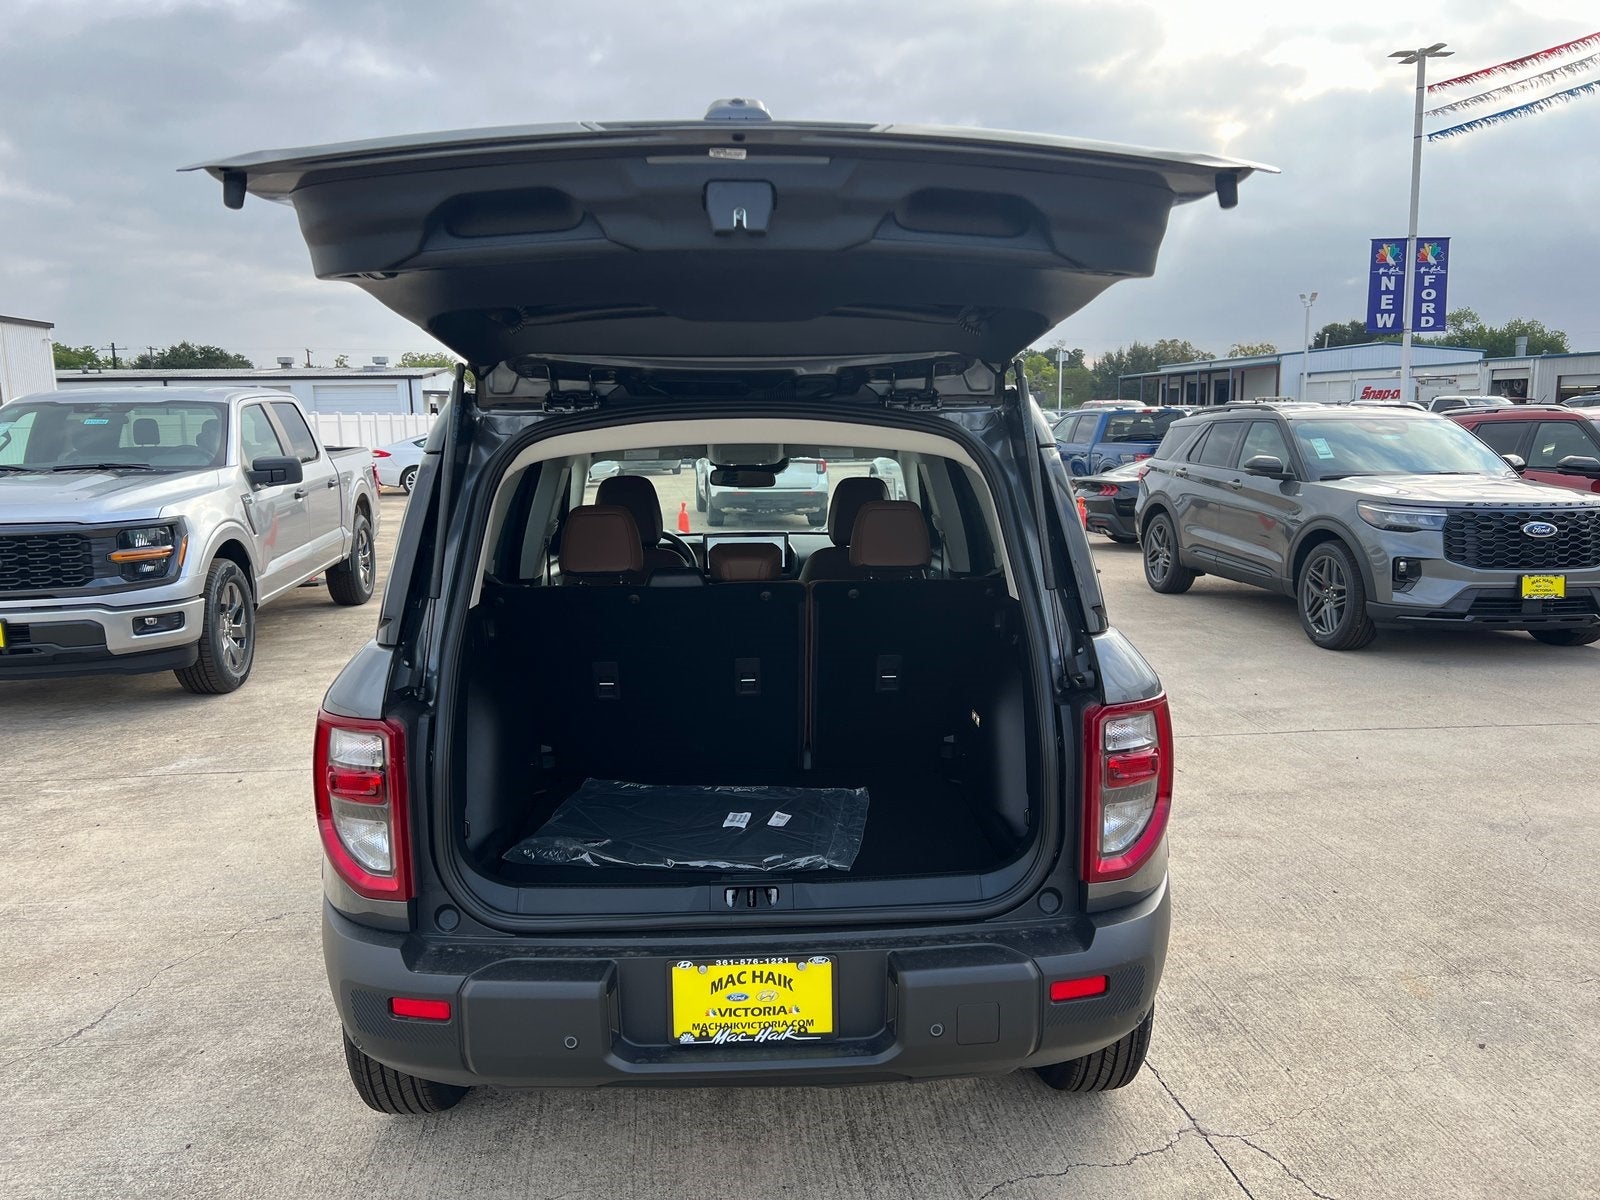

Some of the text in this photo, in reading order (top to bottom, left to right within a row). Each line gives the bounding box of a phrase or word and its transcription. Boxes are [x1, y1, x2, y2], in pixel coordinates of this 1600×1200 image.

[1376, 276, 1395, 328] NEW
[1420, 275, 1436, 328] FORD
[1360, 386, 1401, 401] Snap-o
[715, 957, 789, 966] 361-576-1221
[710, 970, 794, 995] MAC HAIK
[729, 992, 746, 1001] Ford
[717, 1006, 788, 1018] VICTORIA
[711, 1026, 799, 1045] Mac Haik
